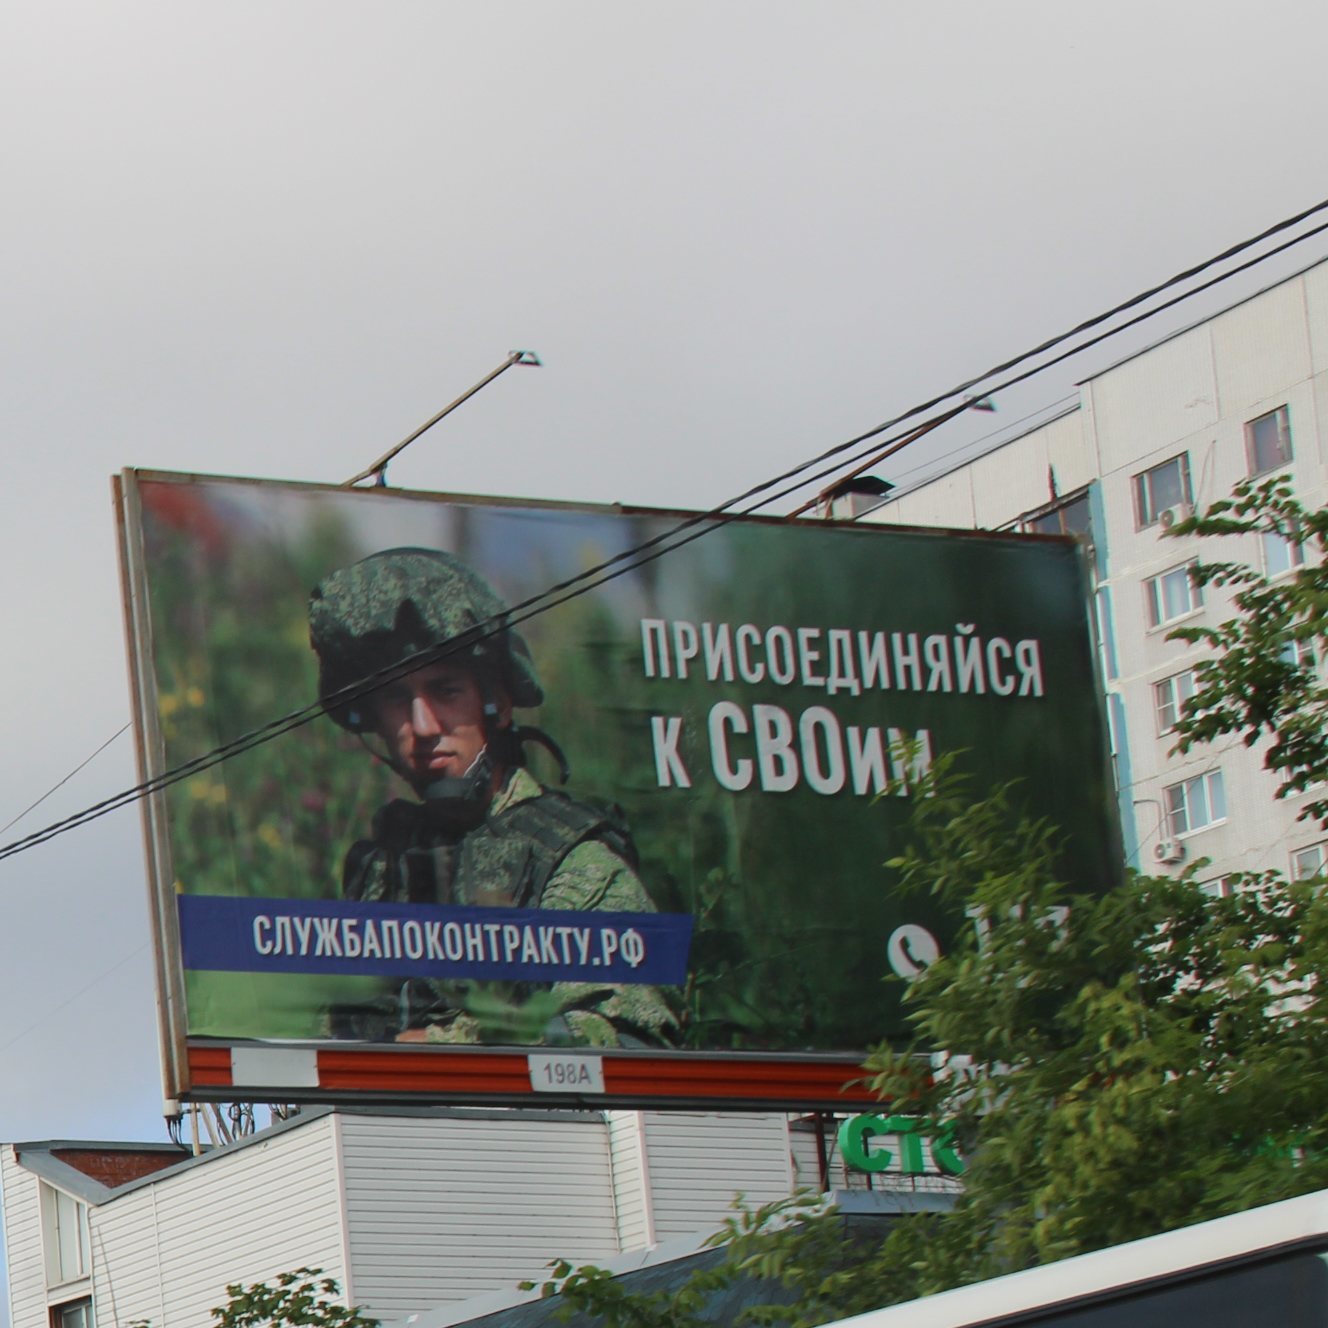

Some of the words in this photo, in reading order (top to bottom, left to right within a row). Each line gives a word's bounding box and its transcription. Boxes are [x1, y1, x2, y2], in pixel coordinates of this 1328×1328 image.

[641, 618, 1045, 697] ПРИСОЕДИНЯЙСЯ
[252, 915, 645, 968] СЛУЖБАПОКОНТРАКТУ.РФ
[543, 1062, 592, 1085] 198A
